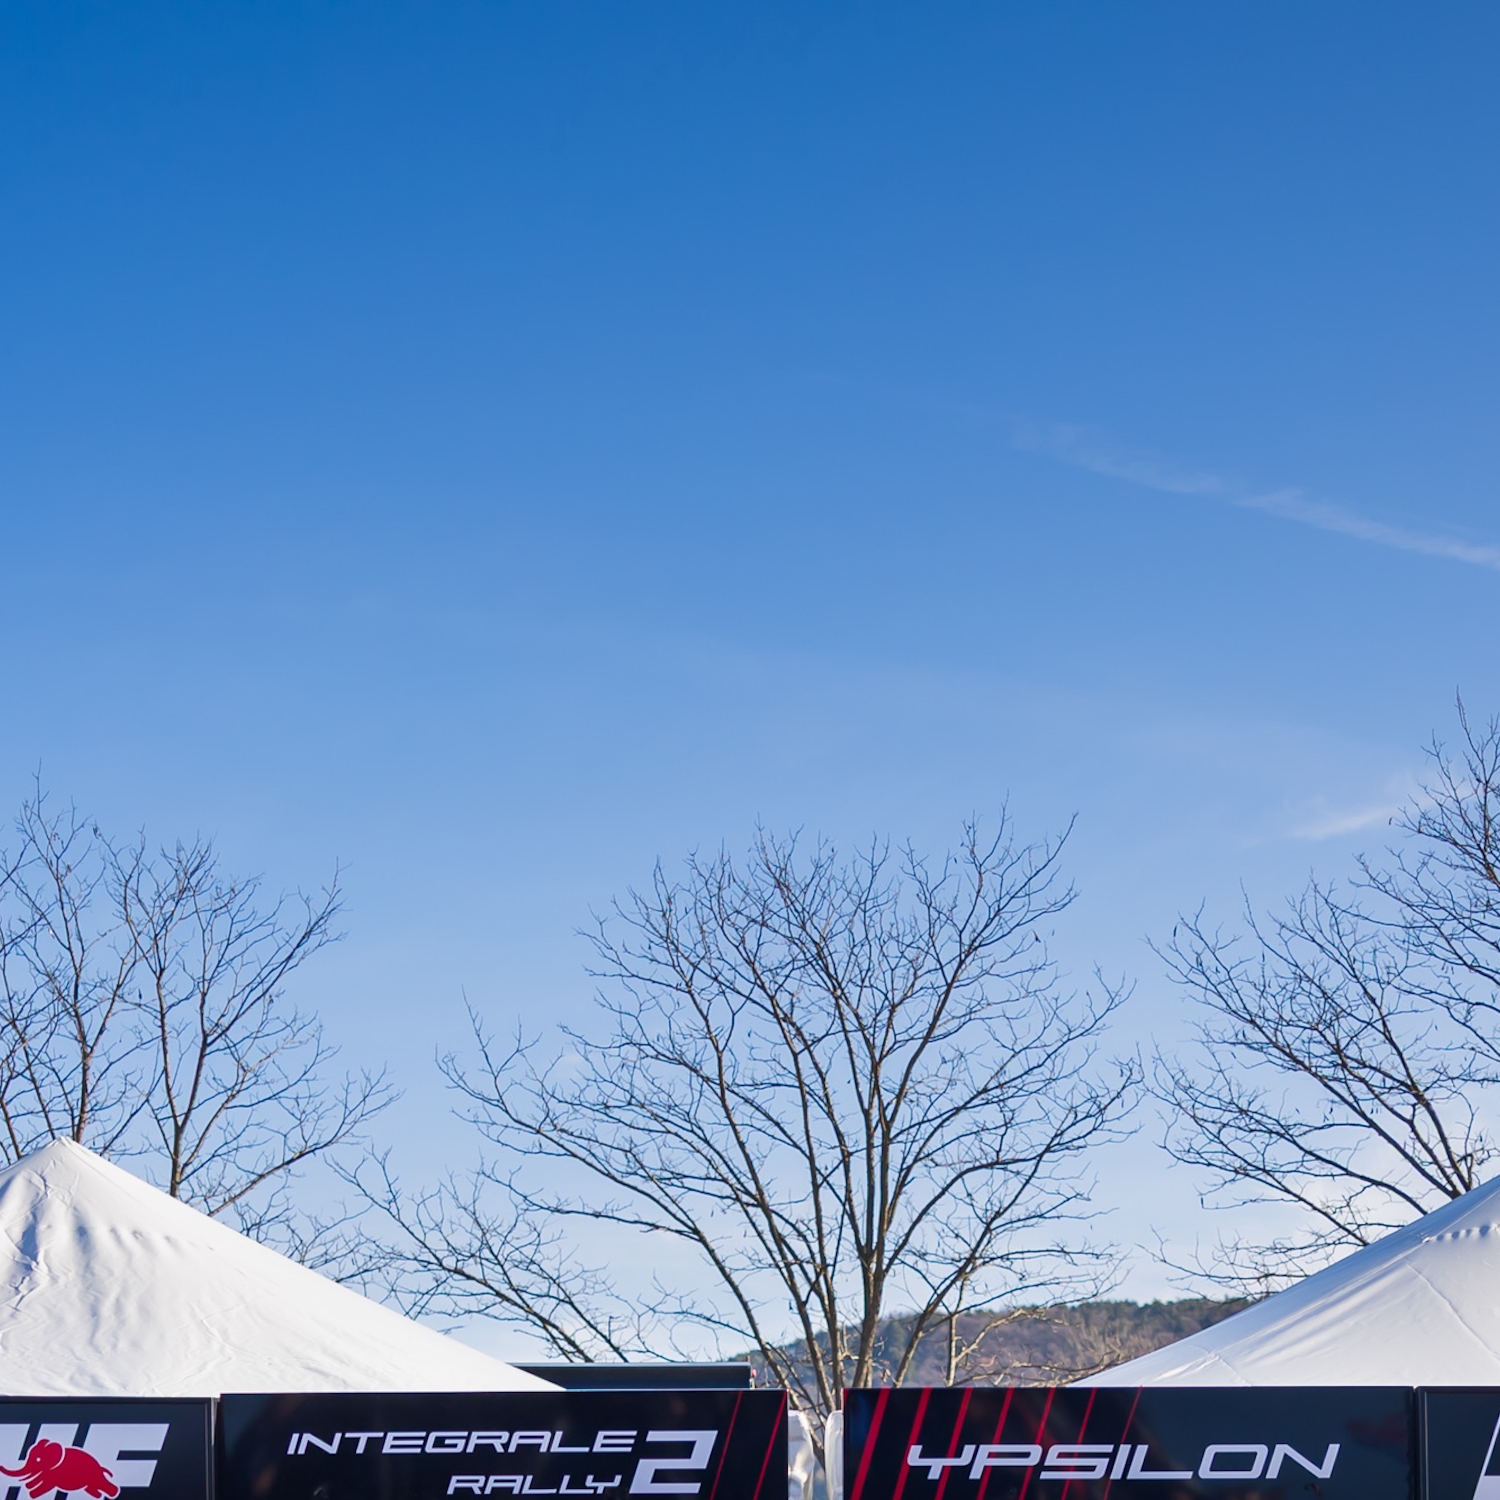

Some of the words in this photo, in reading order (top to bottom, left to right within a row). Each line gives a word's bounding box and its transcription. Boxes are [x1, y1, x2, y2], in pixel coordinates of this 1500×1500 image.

[287, 1430, 638, 1456] INTEGRALE
[629, 1430, 719, 1495] 2
[907, 1443, 1341, 1481] YPSILON
[446, 1474, 622, 1496] RALLY
